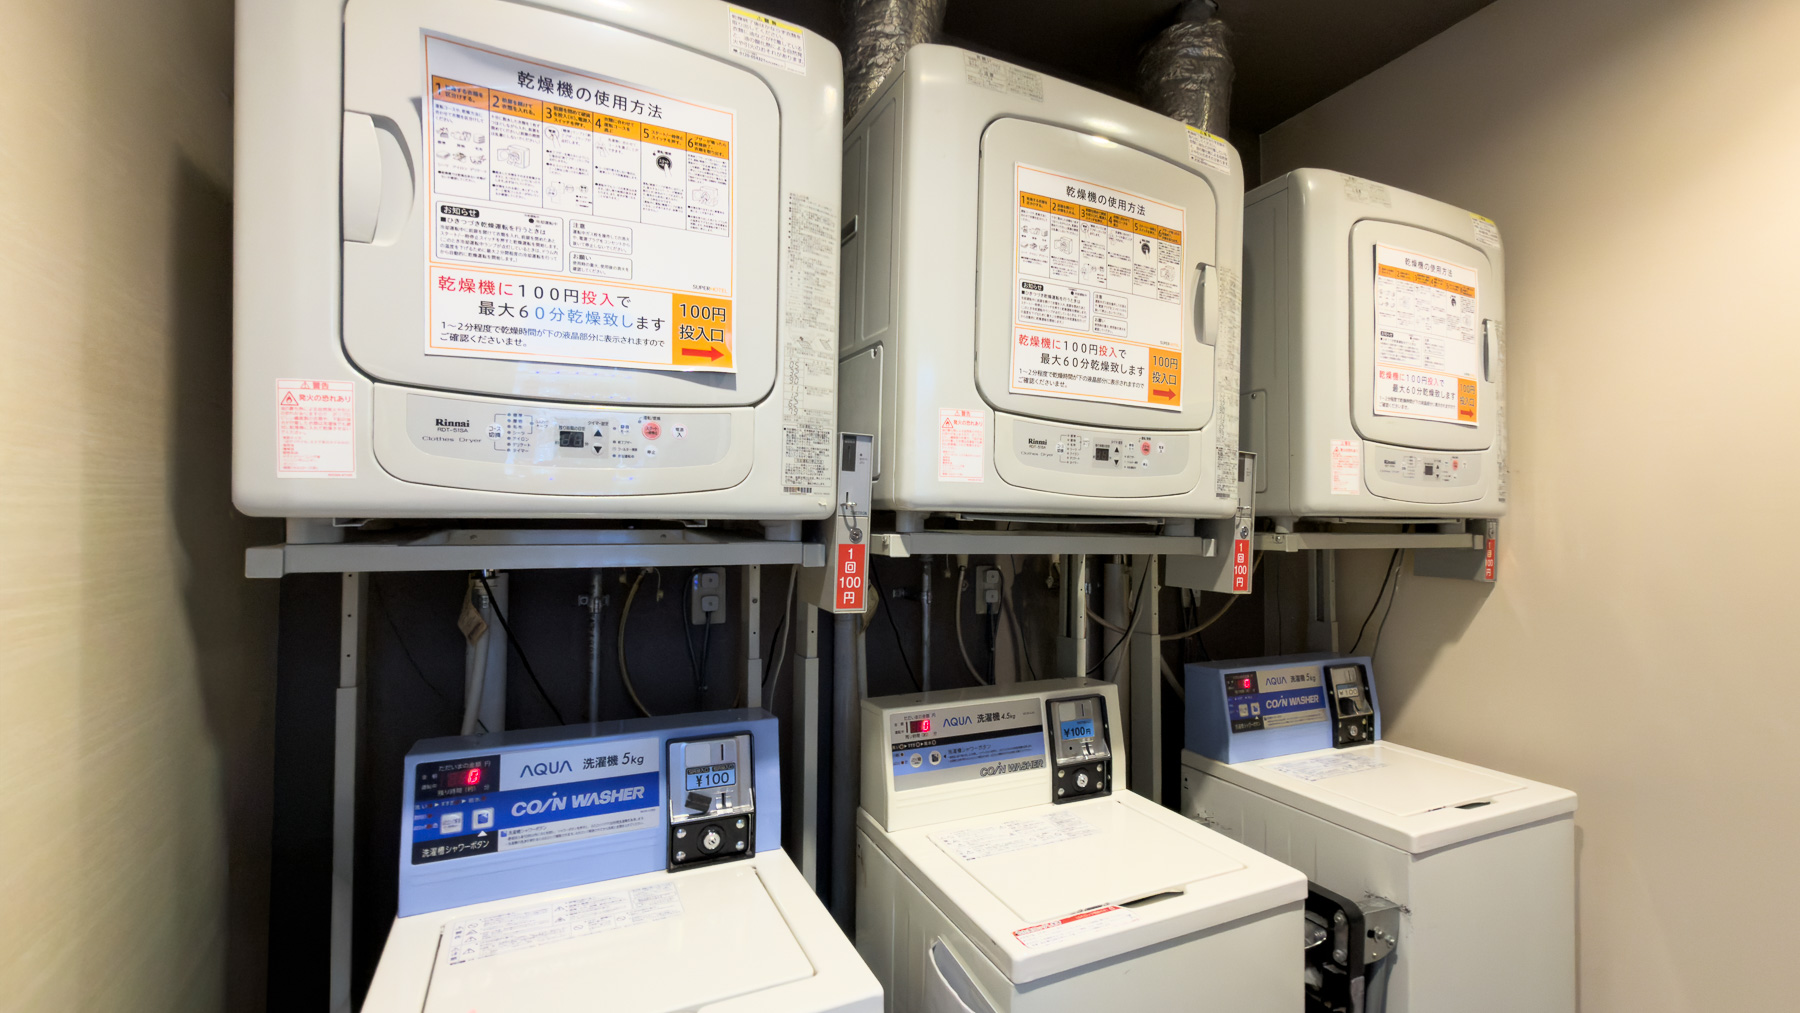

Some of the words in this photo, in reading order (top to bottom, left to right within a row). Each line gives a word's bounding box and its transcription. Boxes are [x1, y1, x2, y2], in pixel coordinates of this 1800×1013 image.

[435, 82, 441, 95] 1
[517, 70, 662, 119] 乾燥機の使用方法
[492, 95, 500, 108] 2
[545, 107, 552, 119] 3
[595, 118, 601, 129] 4
[643, 128, 650, 139] 5
[687, 138, 694, 149] 6
[1021, 195, 1025, 204] 1
[1052, 202, 1057, 211] 2
[1066, 185, 1146, 217] 乾燥機の使用方法
[443, 205, 478, 217] お知らせ
[1081, 209, 1086, 218] 3
[447, 217, 546, 236] ひきつづき乾燥運転を行うときは
[1108, 216, 1113, 224] 4
[1134, 222, 1139, 231] 5
[1158, 229, 1163, 238] 6
[1404, 257, 1453, 278] 乾燥機の使用方法
[438, 275, 631, 308] 乾燥機に100円投入で
[478, 300, 665, 331] 最大60分乾燥致します
[679, 303, 726, 323] 100円
[440, 332, 527, 347] ご確認くださいませ。
[679, 324, 724, 343] 投入口
[1018, 334, 1127, 359] 乾燥機に100円投入で
[1040, 352, 1145, 377] 最大60分乾燥致します
[1152, 355, 1179, 370] 100円
[1017, 376, 1068, 389] ご確認くださいませ。
[1152, 372, 1178, 386] 投入口
[1379, 370, 1445, 387] 乾燥機に100円投入で
[299, 394, 351, 403] 発火の恐れあり
[1392, 383, 1456, 400] 最大60分乾燥致します
[435, 418, 470, 428] Rinnai
[1243, 678, 1251, 689] 0
[1265, 676, 1287, 686] AQUA
[1265, 695, 1288, 709] COIN
[1288, 694, 1320, 706] WASHER
[922, 720, 930, 731] 0
[942, 715, 973, 728] AQUA
[977, 713, 1001, 724] 洗濯機
[1001, 712, 1016, 720] 4.5kg
[439, 761, 482, 771] ただいまの金額
[520, 760, 572, 778] AQUA
[582, 754, 619, 770] 洗濯機
[621, 752, 645, 766] 5kg
[980, 762, 1006, 777] COIN
[1008, 759, 1043, 773] WASHER
[467, 768, 481, 785] 0
[695, 772, 729, 787] ¥100
[511, 791, 567, 817] COIN
[571, 785, 645, 808] WASHER
[421, 840, 490, 858] 洗濯槽シャワーボタン
